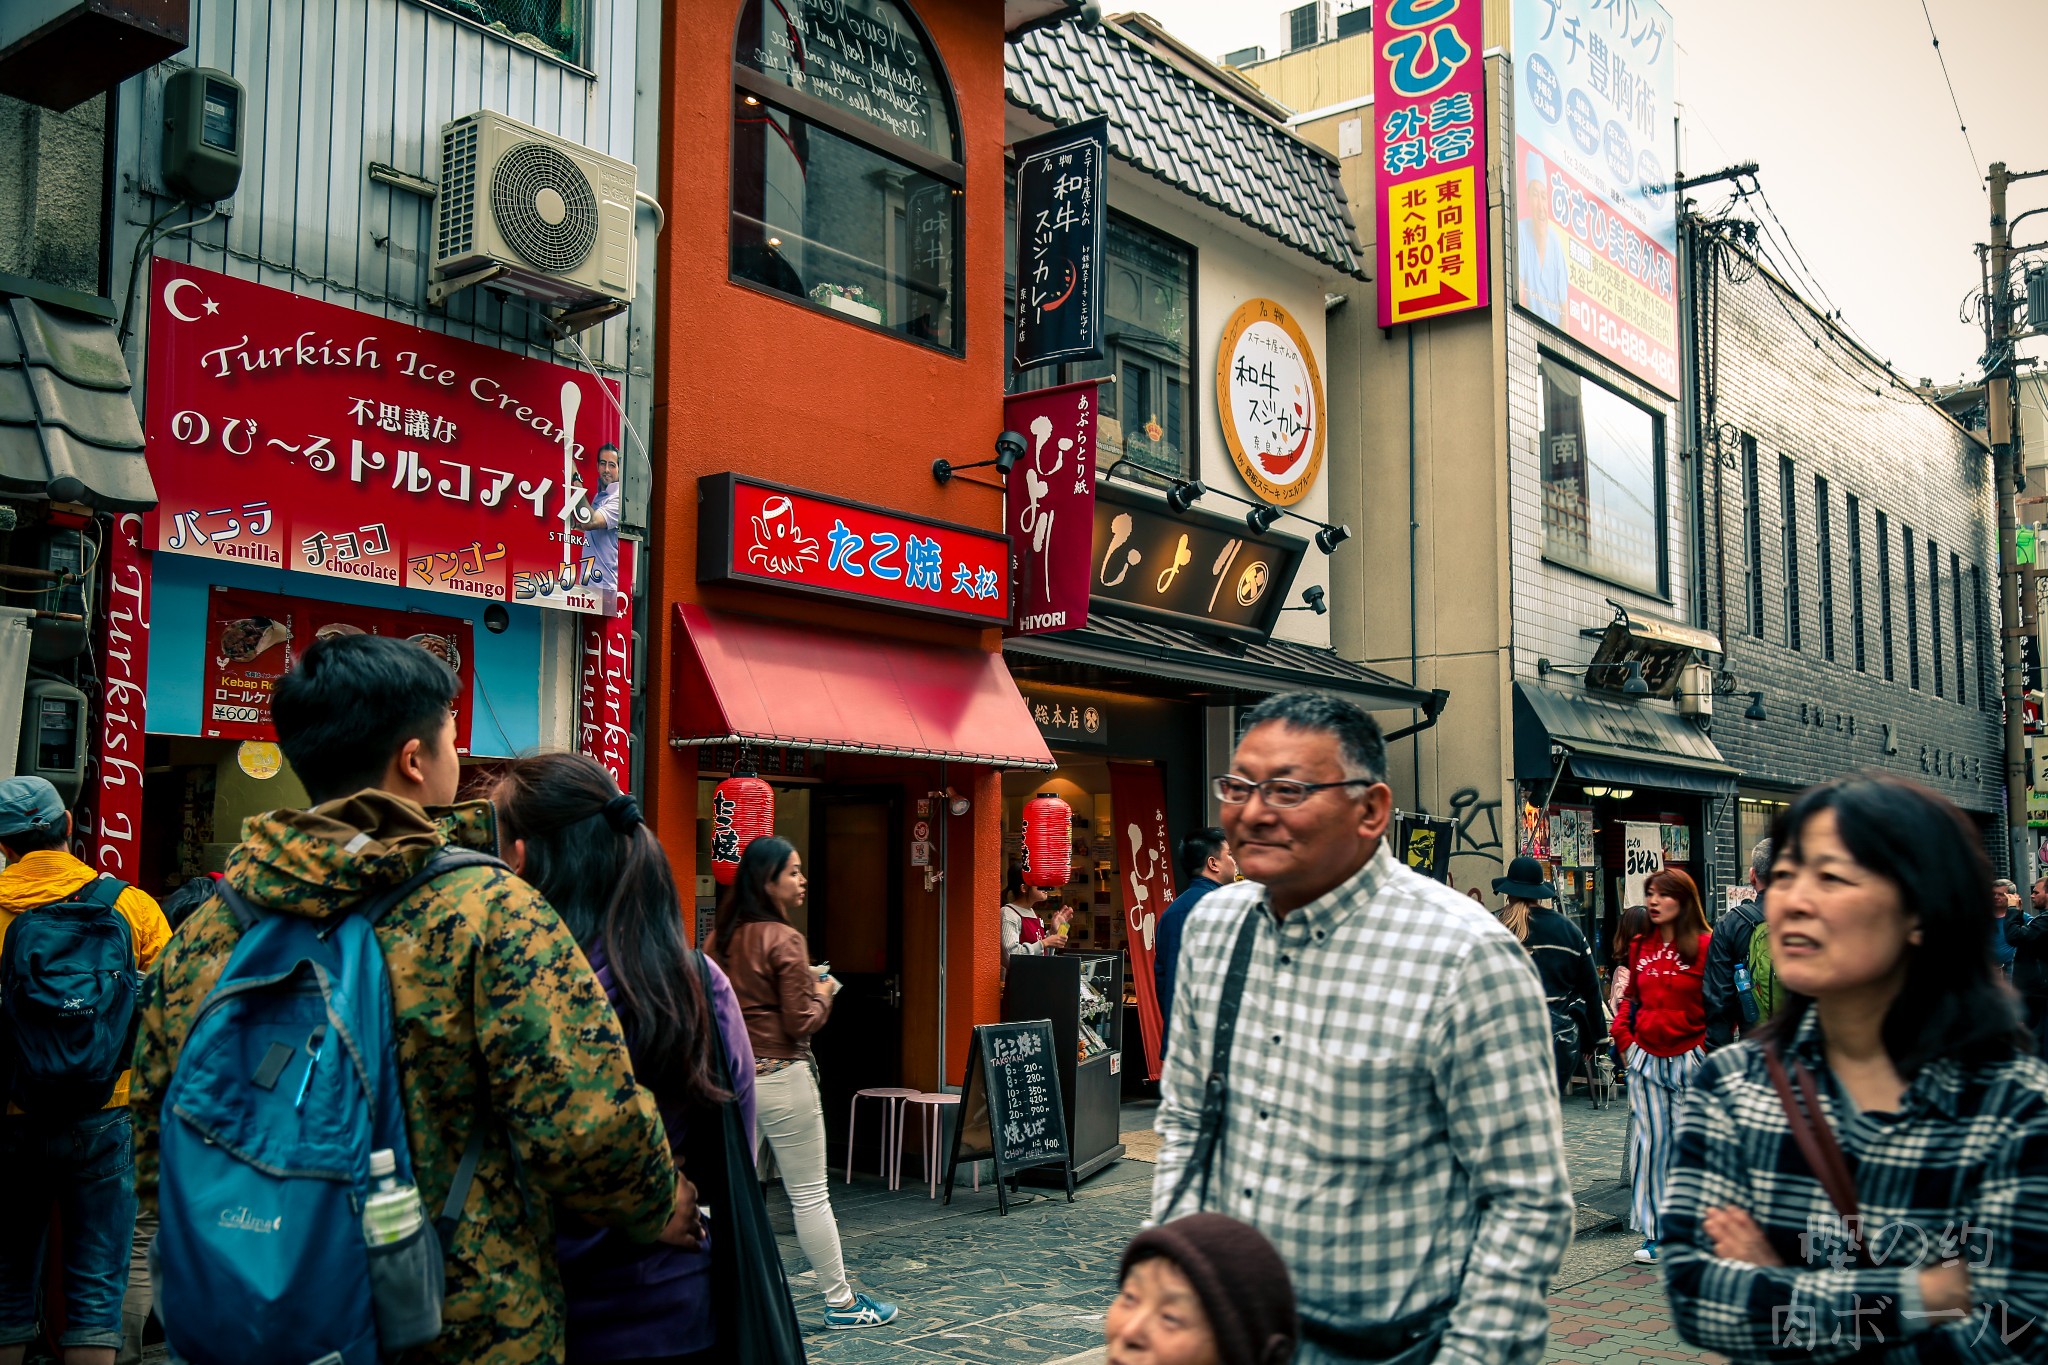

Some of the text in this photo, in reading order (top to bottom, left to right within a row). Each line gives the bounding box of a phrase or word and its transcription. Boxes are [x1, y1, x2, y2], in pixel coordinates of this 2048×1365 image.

[1383, 92, 1474, 176] 美容 外科
[1053, 173, 1082, 232] 和牛
[1435, 179, 1465, 277] 東向信号
[1551, 172, 1673, 302] あさひ美容外科
[1031, 209, 1053, 325] スジカレー
[201, 331, 587, 462] Turkish Ice Cream
[1235, 355, 1280, 399] 和牛
[347, 396, 457, 444] 不思議な
[1249, 399, 1312, 437] スジカレー
[1073, 395, 1090, 495] あぶらとり紙
[168, 501, 274, 550] バニラ
[1020, 415, 1073, 602] ひより
[213, 540, 281, 564] vanilla
[301, 523, 391, 568] チョコ
[325, 554, 398, 582] chocolate
[407, 540, 507, 585] マンゴー
[827, 518, 942, 593] たこ焼
[951, 563, 999, 600] 大松
[1100, 512, 1243, 613] ひより
[449, 576, 505, 600] mango
[512, 554, 602, 600] ミックス
[566, 592, 597, 610] mix
[1020, 611, 1066, 631] HIYORI
[103, 565, 152, 791] Turkish
[222, 677, 258, 690] Kebap
[214, 705, 258, 721] ¥600
[603, 632, 632, 796] Turkis
[1034, 703, 1080, 729] 総本店
[1155, 808, 1174, 902] あぶらとり紙
[990, 1054, 1025, 1067] TAKOYAKI
[993, 1031, 1042, 1057] たこ焼き
[1004, 1117, 1047, 1147] 焼そば
